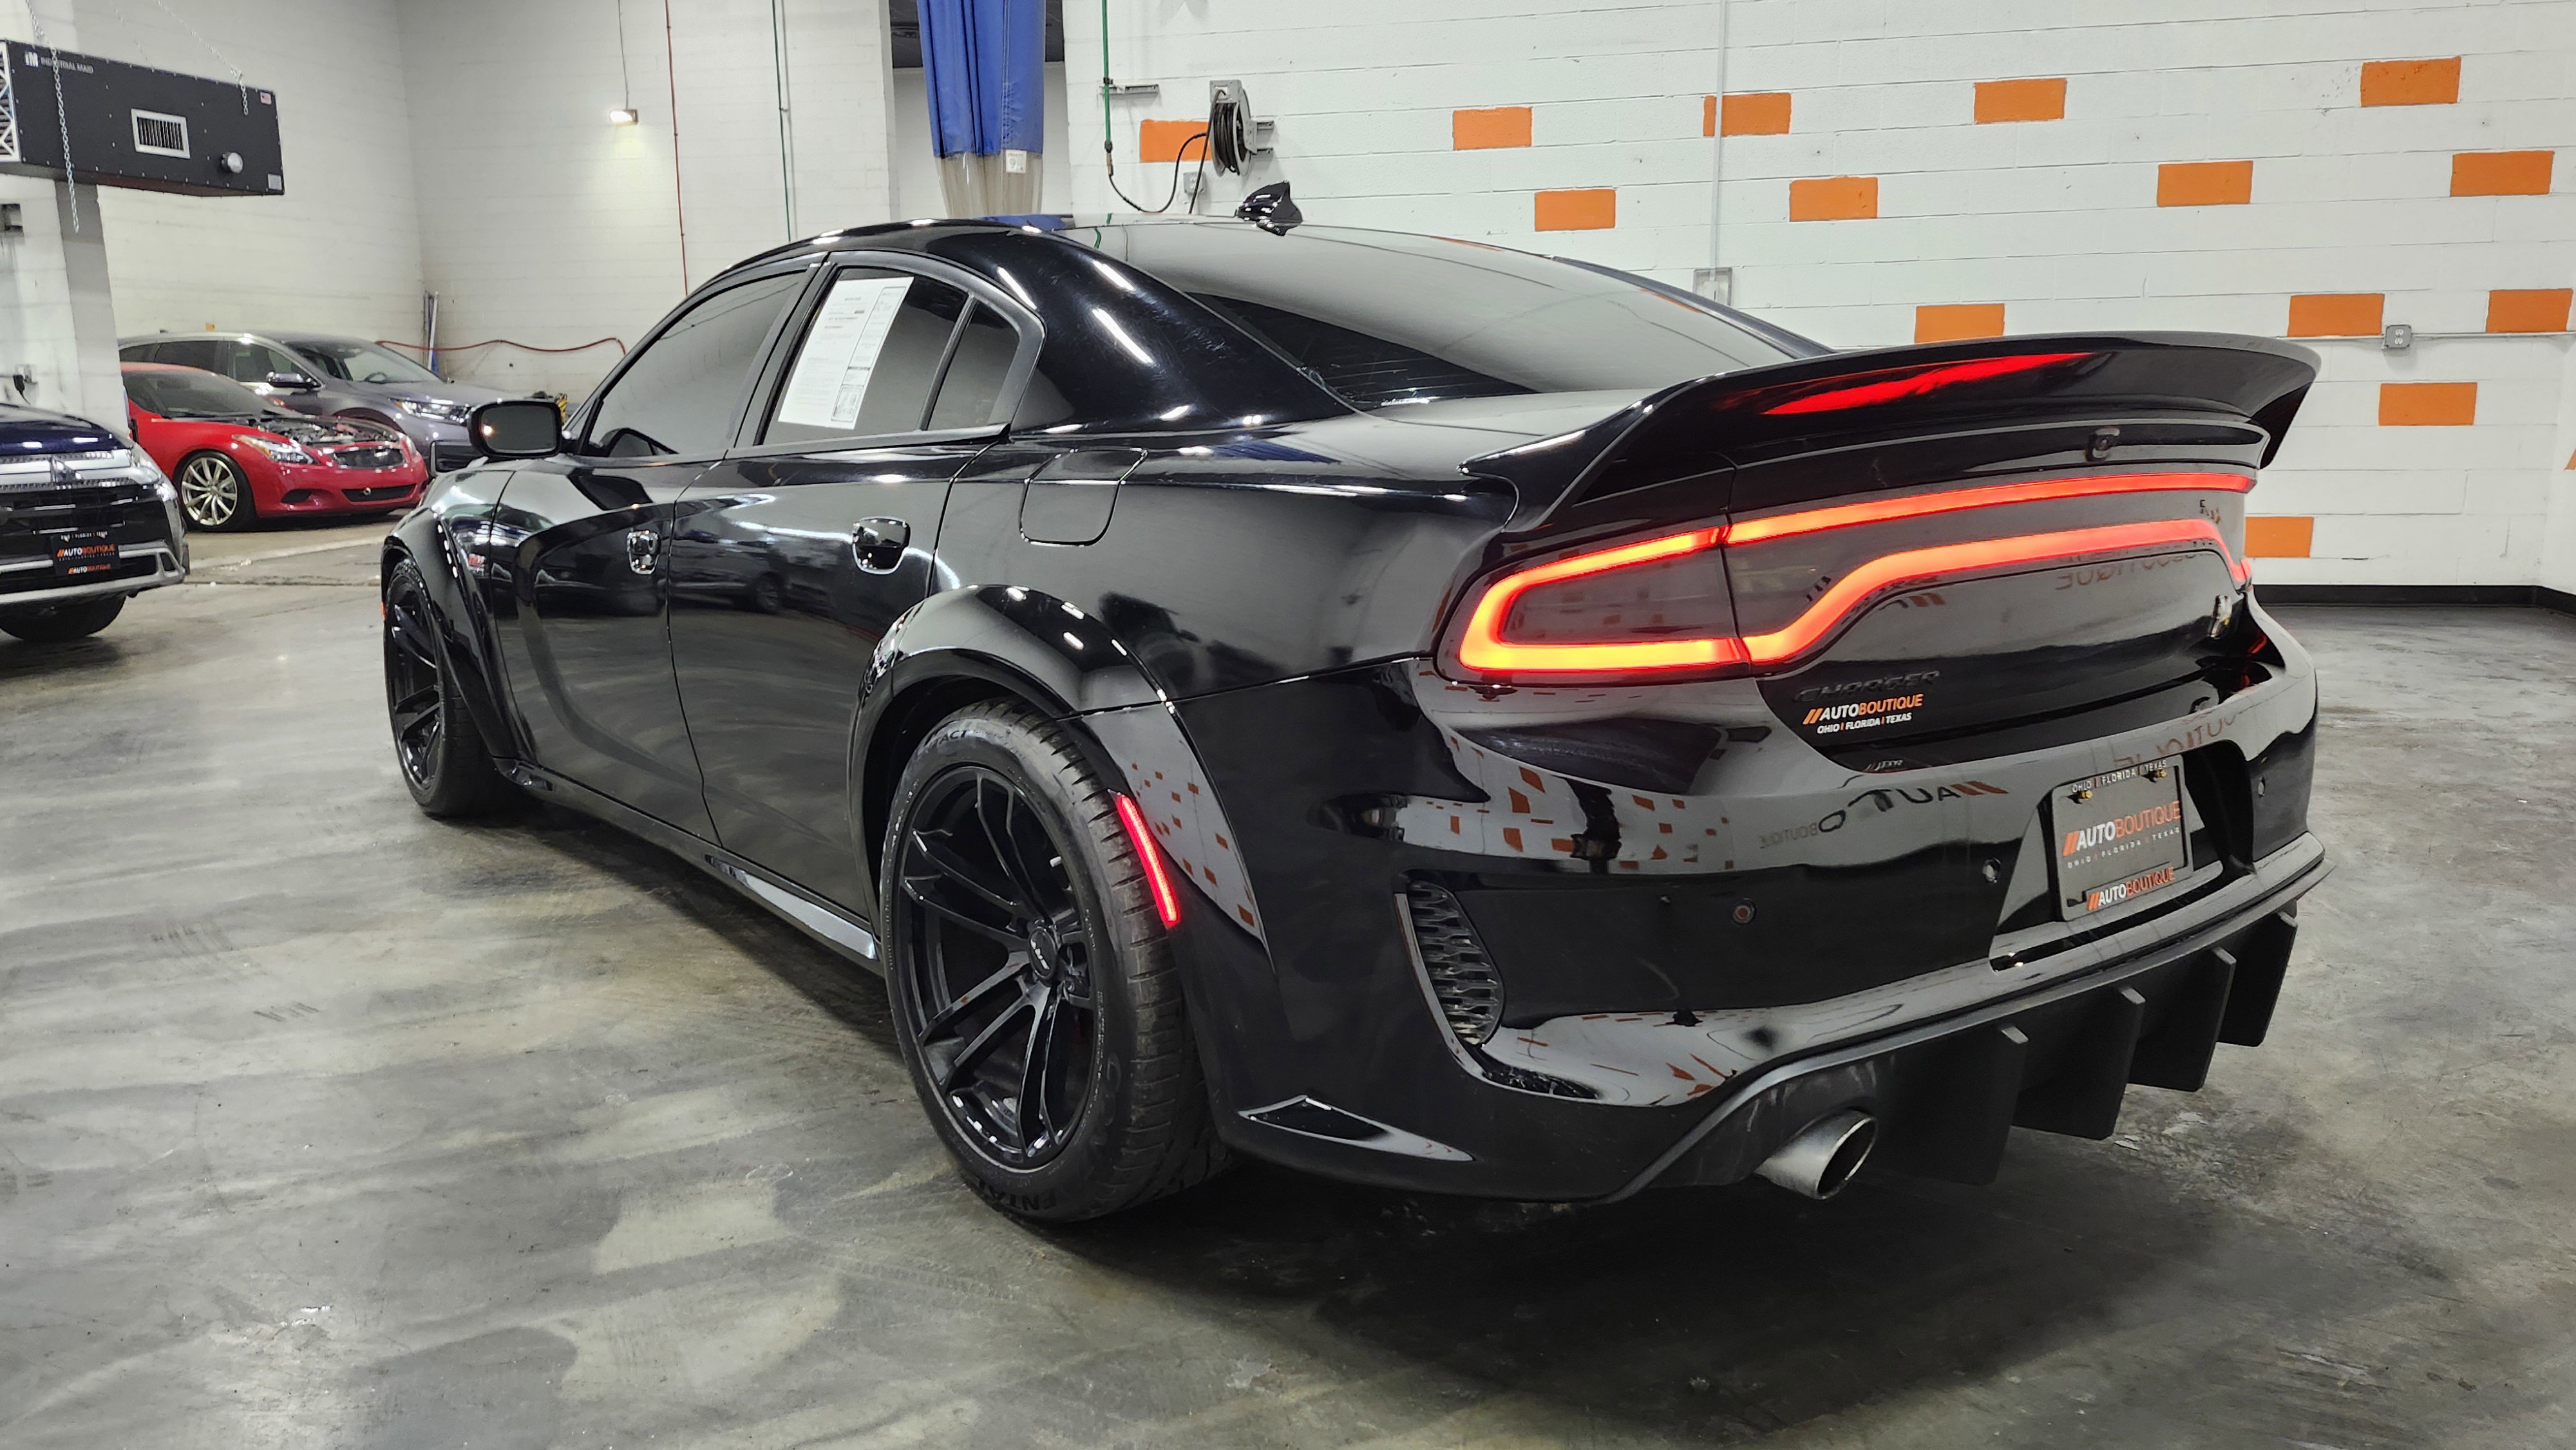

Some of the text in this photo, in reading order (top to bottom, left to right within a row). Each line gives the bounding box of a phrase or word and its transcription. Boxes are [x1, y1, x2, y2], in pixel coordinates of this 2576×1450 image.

[1793, 670, 1940, 703] CHARGER
[1817, 711, 1913, 734] OHIO FLORIDA TEXAS
[2072, 759, 2167, 793] OHIO FLORIDA TEXAS
[2067, 827, 2181, 869] OHIO FLORIDA TEXAS
